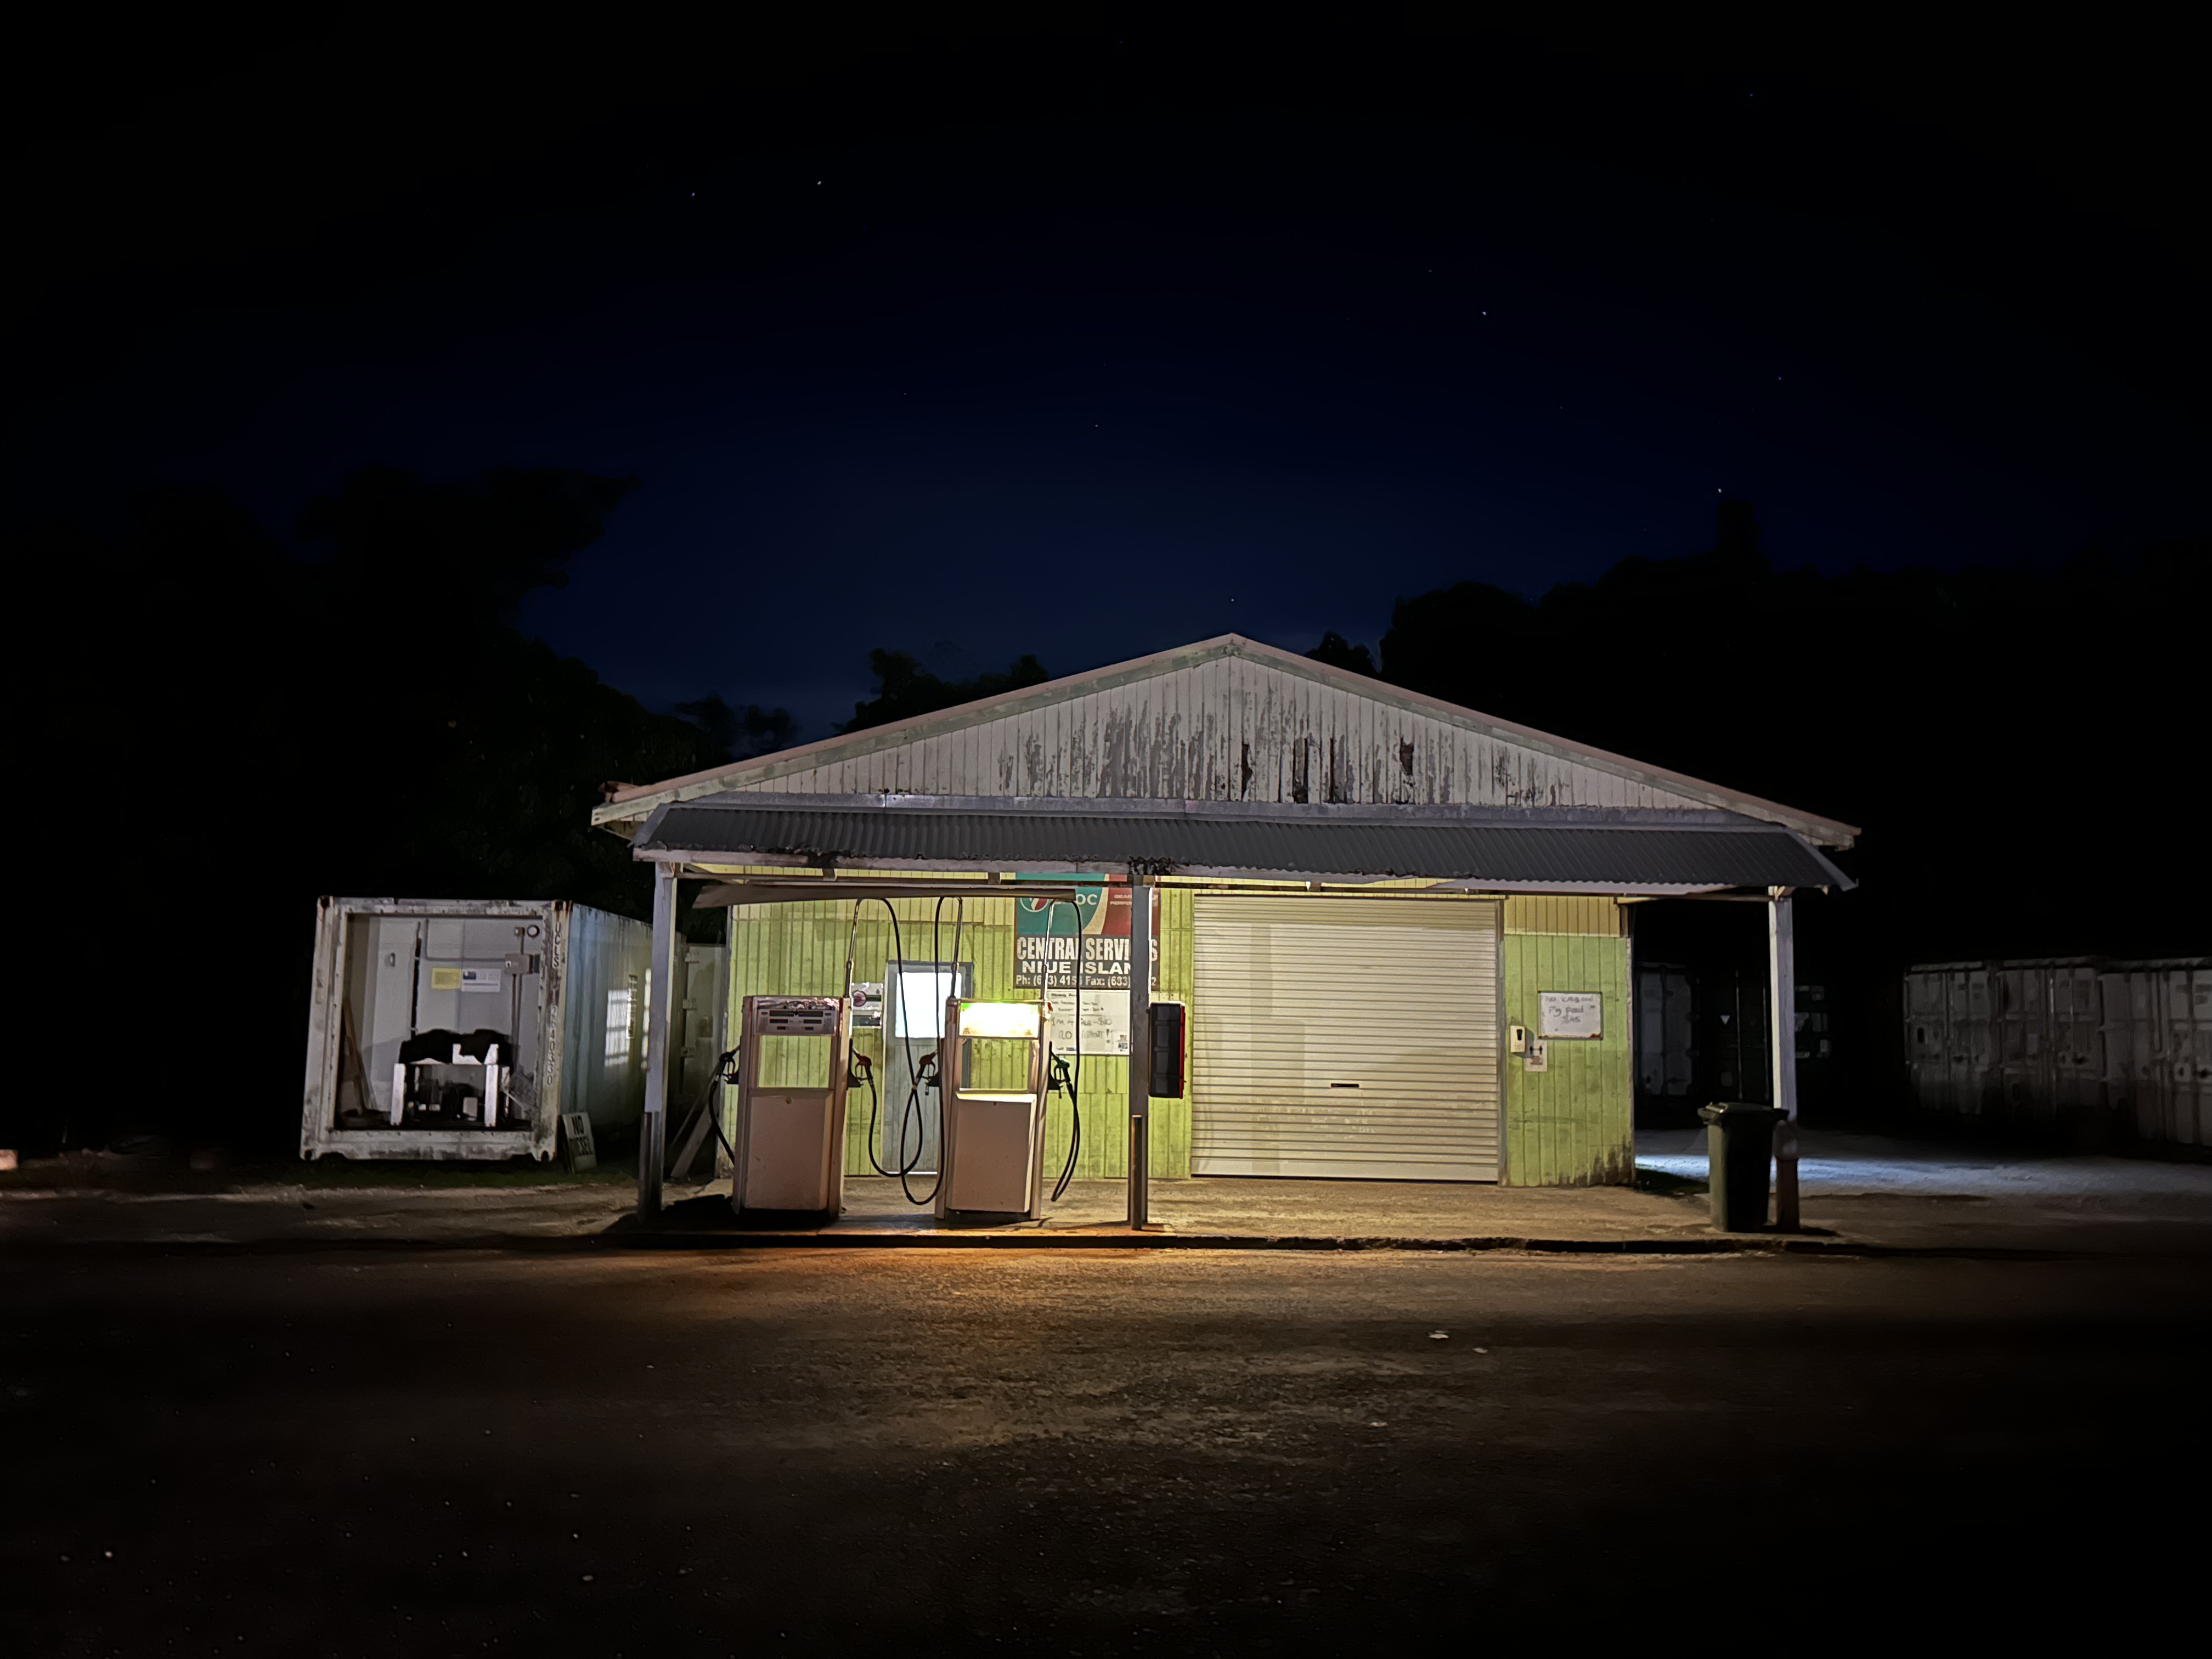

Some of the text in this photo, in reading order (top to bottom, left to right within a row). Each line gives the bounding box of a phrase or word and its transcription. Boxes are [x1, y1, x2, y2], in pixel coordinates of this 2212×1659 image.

[1086, 938, 1158, 961] SERVIS
[1022, 961, 1071, 974] NIUE
[1016, 975, 1030, 985] Ph:
[1033, 975, 1057, 987] (63)
[1085, 975, 1105, 986] Fax:
[571, 1115, 584, 1135] NO
